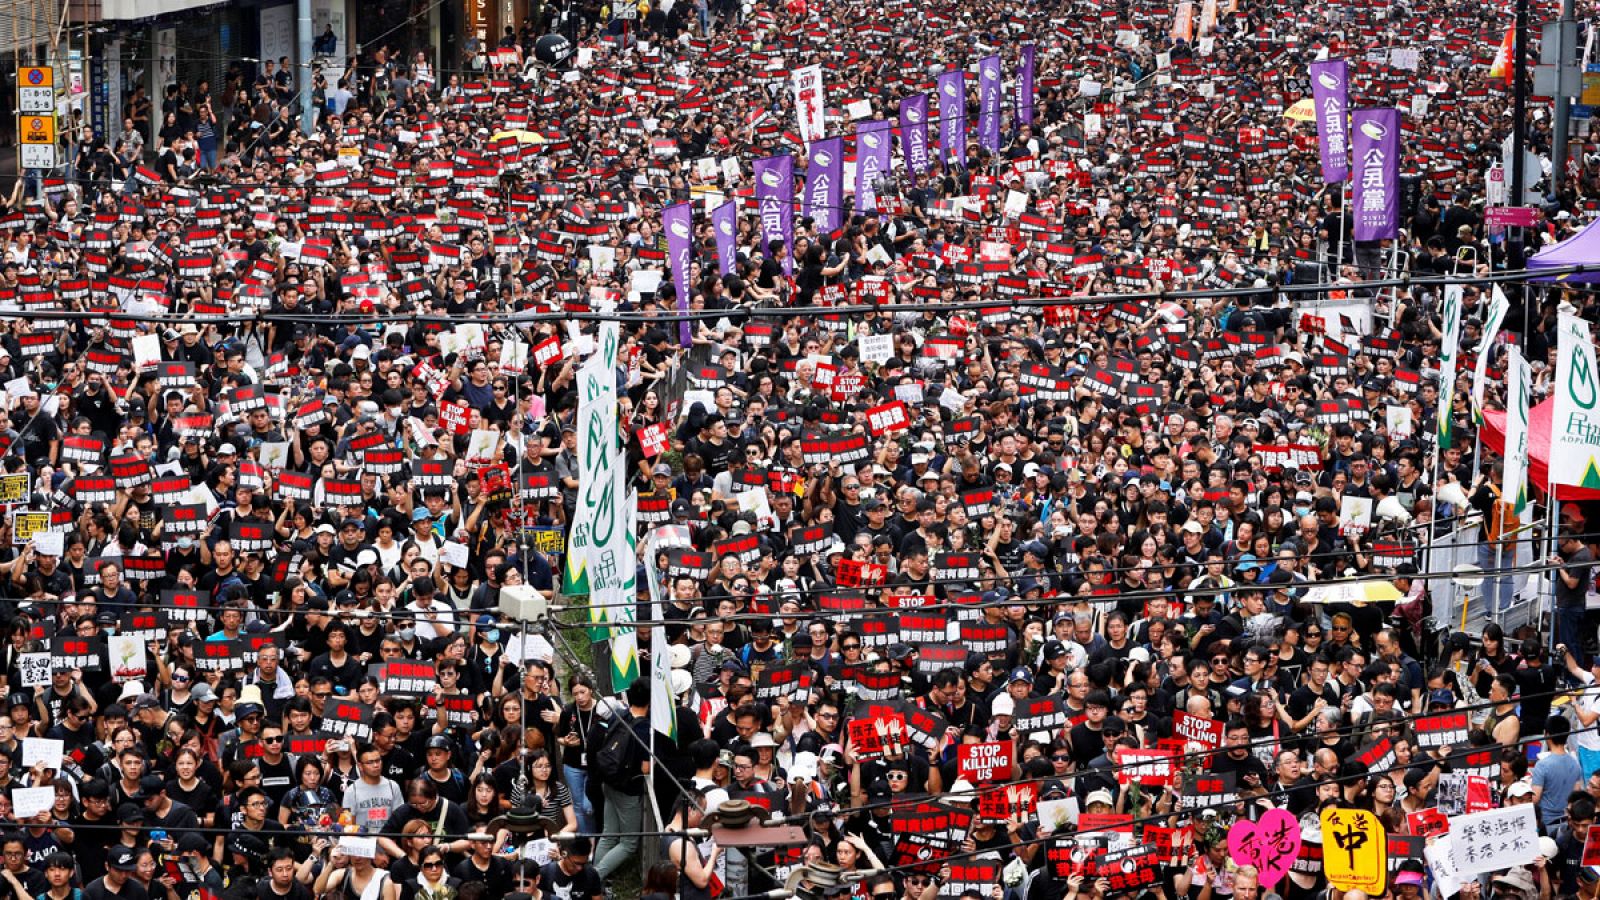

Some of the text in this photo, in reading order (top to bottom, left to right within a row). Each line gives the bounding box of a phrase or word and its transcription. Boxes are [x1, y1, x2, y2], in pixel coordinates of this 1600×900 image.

[447, 403, 465, 414] STOP
[441, 411, 467, 426] KILLING
[899, 596, 925, 607] STOP
[1183, 715, 1212, 729] STOP
[1175, 722, 1217, 744] KILLING
[970, 745, 1001, 758] STOP
[962, 755, 1008, 771] KILLING
[976, 769, 993, 781] US
[1237, 818, 1295, 860] 香港
[1332, 823, 1369, 871] 中
